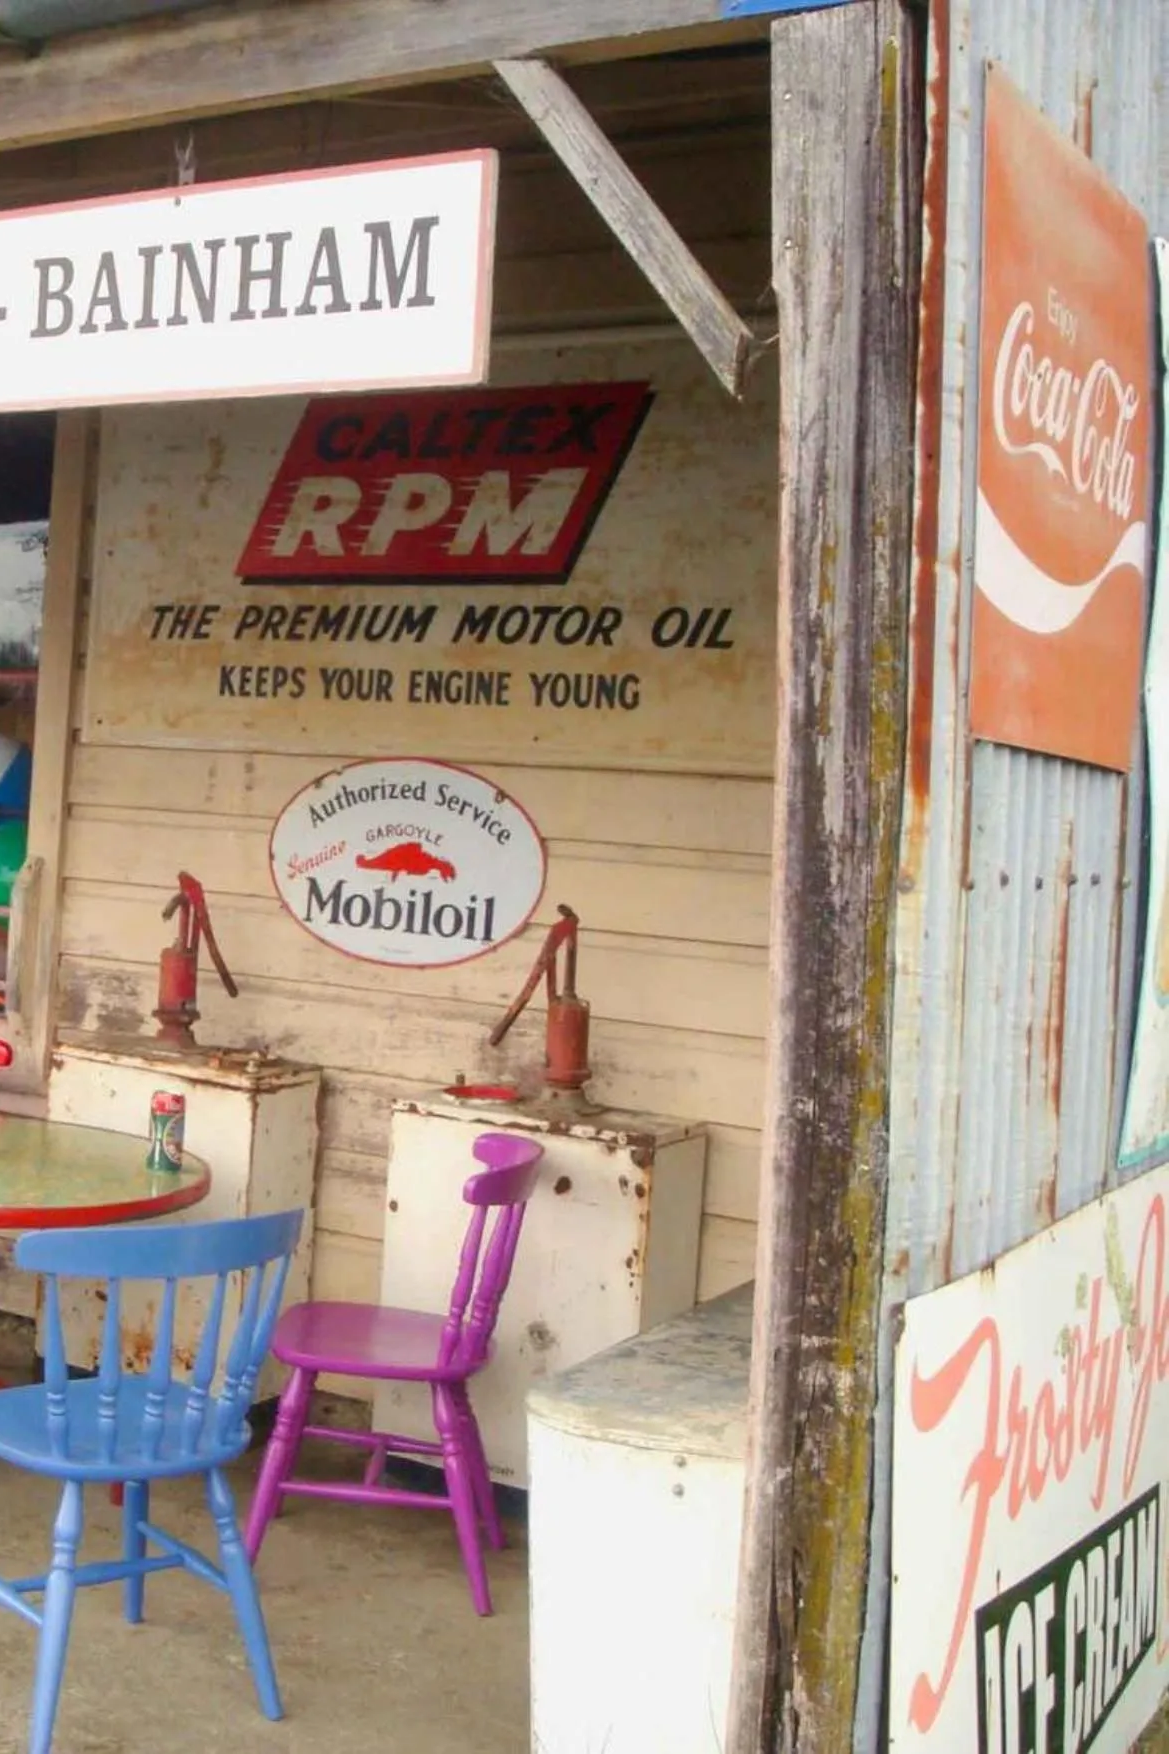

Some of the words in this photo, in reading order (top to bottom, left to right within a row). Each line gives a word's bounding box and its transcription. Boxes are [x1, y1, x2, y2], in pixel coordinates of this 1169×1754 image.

[30, 215, 439, 339] BAINHAM
[1047, 286, 1078, 345] Enjoy
[315, 402, 614, 463] CALTEX
[993, 301, 1139, 520] Coca-Cola
[261, 467, 590, 557] RPM
[150, 605, 220, 640] THE
[233, 604, 437, 642] PREMIUM
[451, 605, 623, 646] MOTOR
[651, 606, 735, 649] OIL
[219, 665, 306, 699] KEEPS
[319, 667, 393, 703] YOUR
[408, 670, 511, 706] ENGINE
[529, 671, 641, 711] YOUNG
[309, 779, 426, 829] Authorized
[435, 784, 512, 846] Service
[365, 824, 445, 848] GARGOYLE
[286, 839, 347, 880] Genuine
[303, 876, 495, 942] Mobiloil
[908, 1276, 1124, 1734] Frosty
[984, 1580, 1056, 1754] ICE
[1063, 1497, 1160, 1754] CREAM
